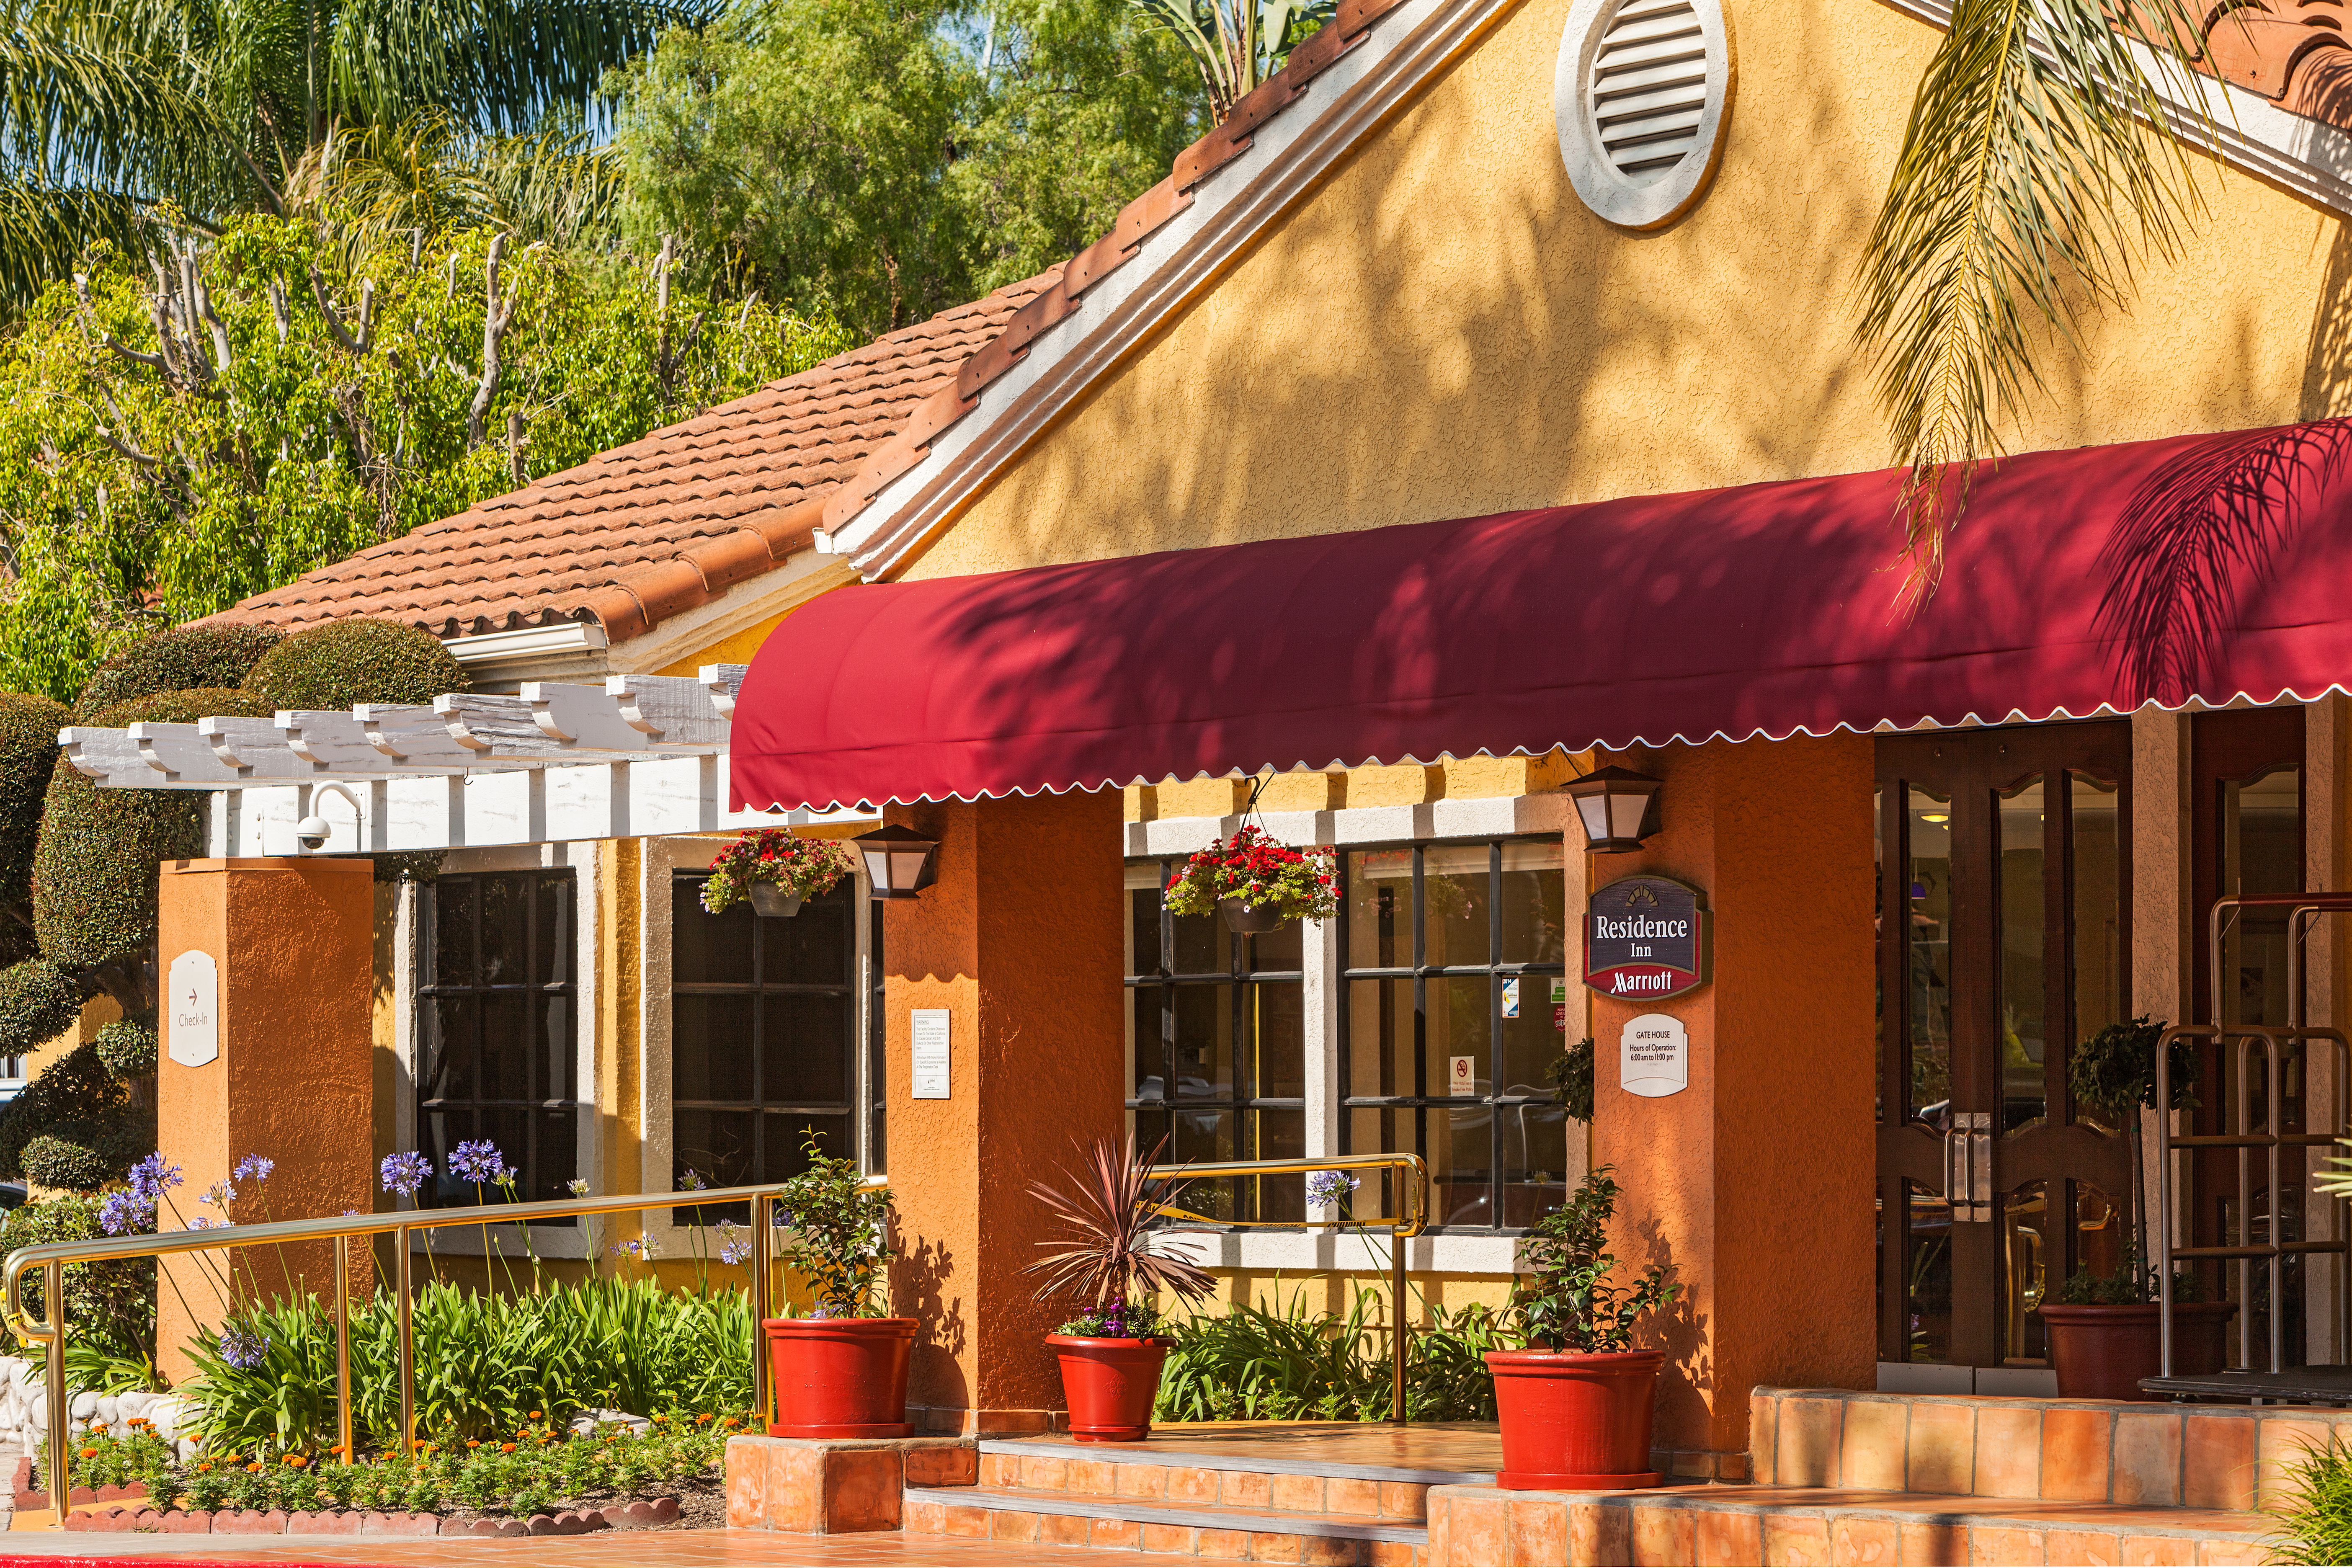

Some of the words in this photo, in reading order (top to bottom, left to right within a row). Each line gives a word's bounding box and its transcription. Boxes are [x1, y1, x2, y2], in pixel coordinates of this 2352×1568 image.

[1596, 914, 1687, 939] Residence
[1631, 943, 1652, 957] Inn
[1610, 971, 1672, 994] Marriott
[179, 1012, 208, 1026] Check-In
[1651, 1044, 1676, 1053] Operation:
